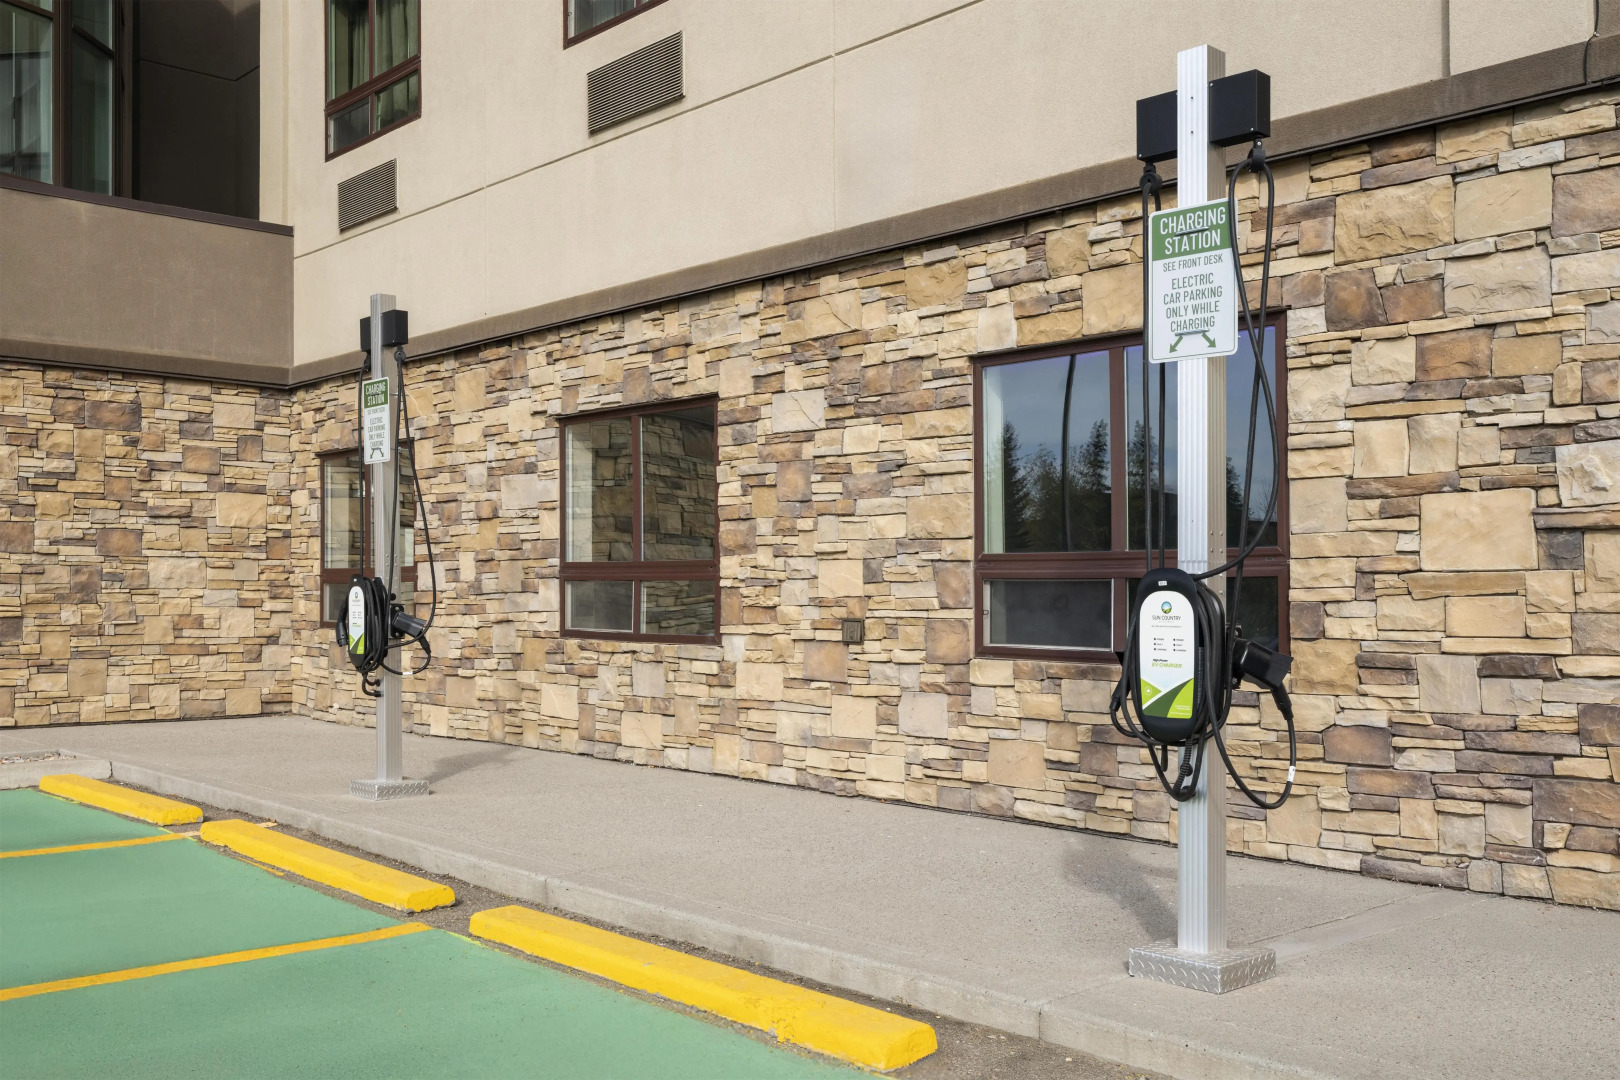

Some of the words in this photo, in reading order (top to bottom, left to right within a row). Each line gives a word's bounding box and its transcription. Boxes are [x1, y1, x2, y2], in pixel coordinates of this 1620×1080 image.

[1159, 206, 1226, 235] CHARGING
[1164, 229, 1221, 255] STATION
[1162, 261, 1176, 273] SEE
[1178, 257, 1202, 270] FRONT
[1203, 253, 1224, 266] DESK
[1171, 272, 1214, 290] ELECTRIC
[1163, 292, 1181, 305] CAR
[1183, 285, 1223, 303] PARKING
[1165, 305, 1189, 319] ONLY
[1191, 300, 1220, 315] WHILE
[1170, 316, 1215, 333] CHARGING
[366, 382, 386, 394] CHARGING
[368, 394, 384, 406] STATION
